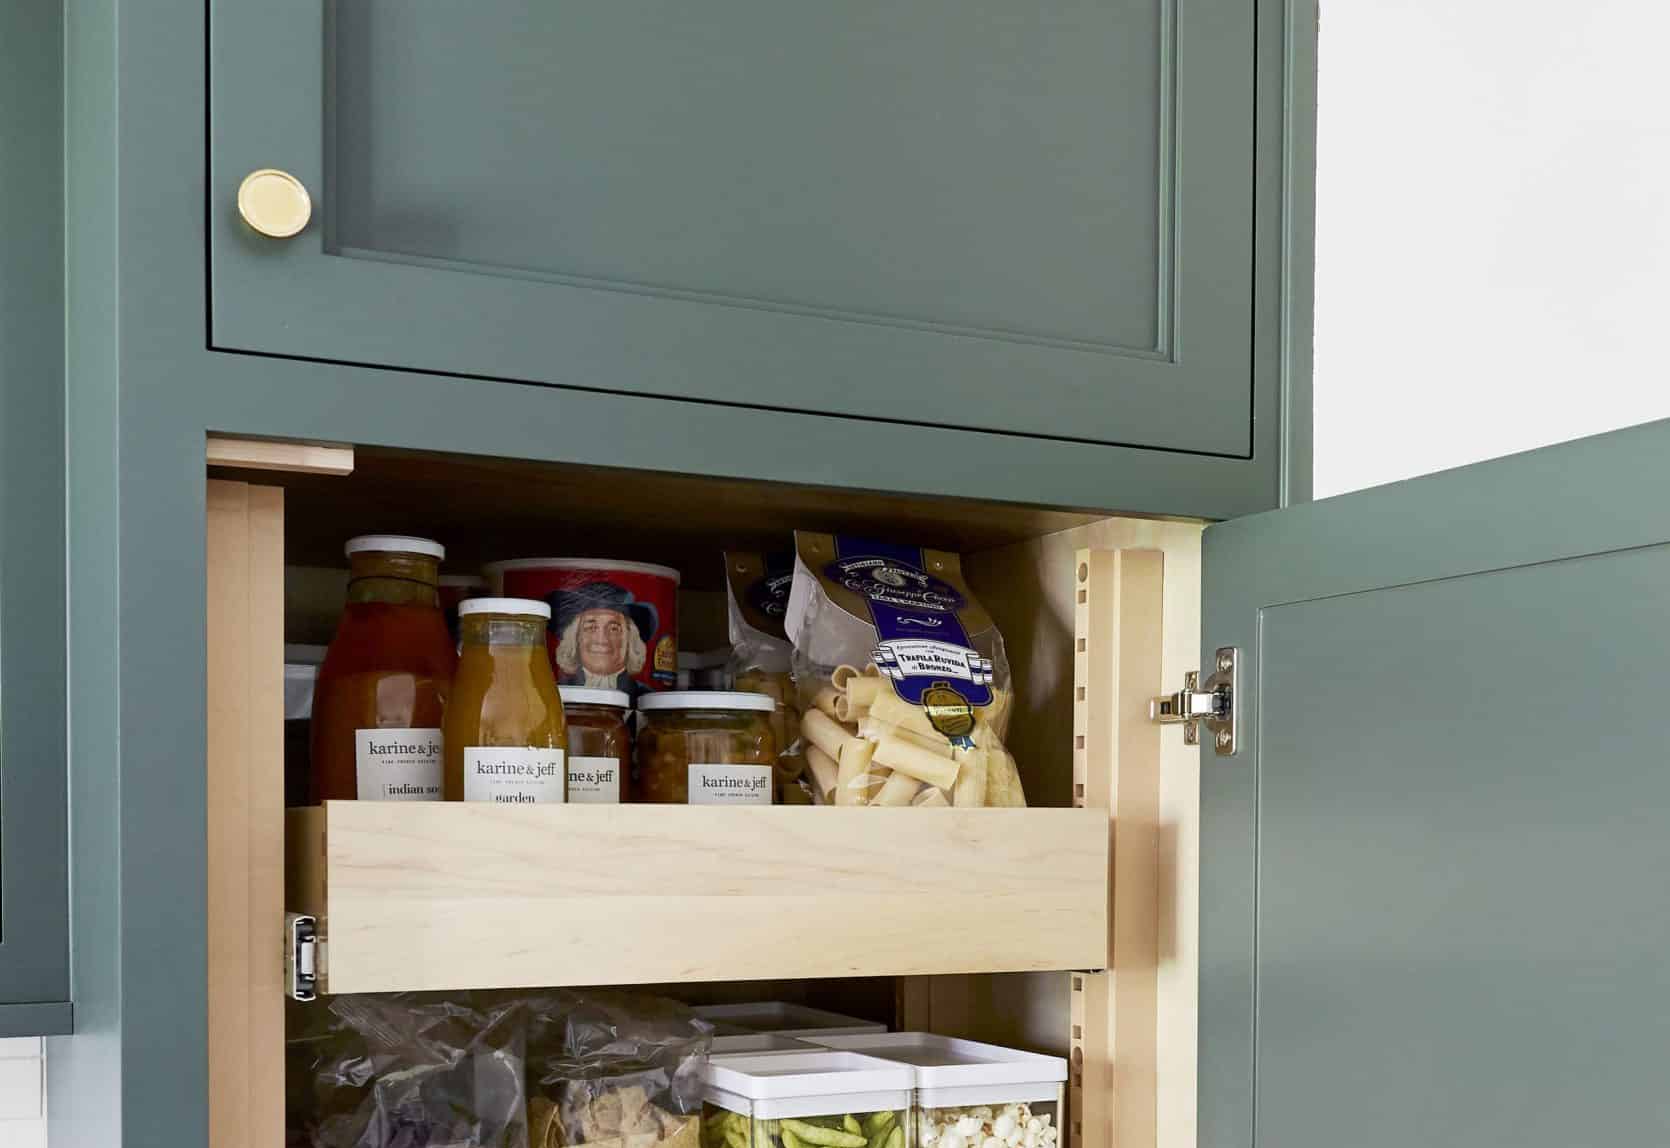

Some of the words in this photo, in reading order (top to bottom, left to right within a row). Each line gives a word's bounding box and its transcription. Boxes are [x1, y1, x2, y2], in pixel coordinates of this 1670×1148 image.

[368, 741, 417, 755] karine
[426, 740, 440, 757] je
[476, 760, 525, 775] karine
[535, 762, 557, 779] jeff
[594, 769, 614, 785] jeff
[388, 783, 424, 795] indian
[702, 775, 744, 788] karine
[751, 776, 768, 792] jeff
